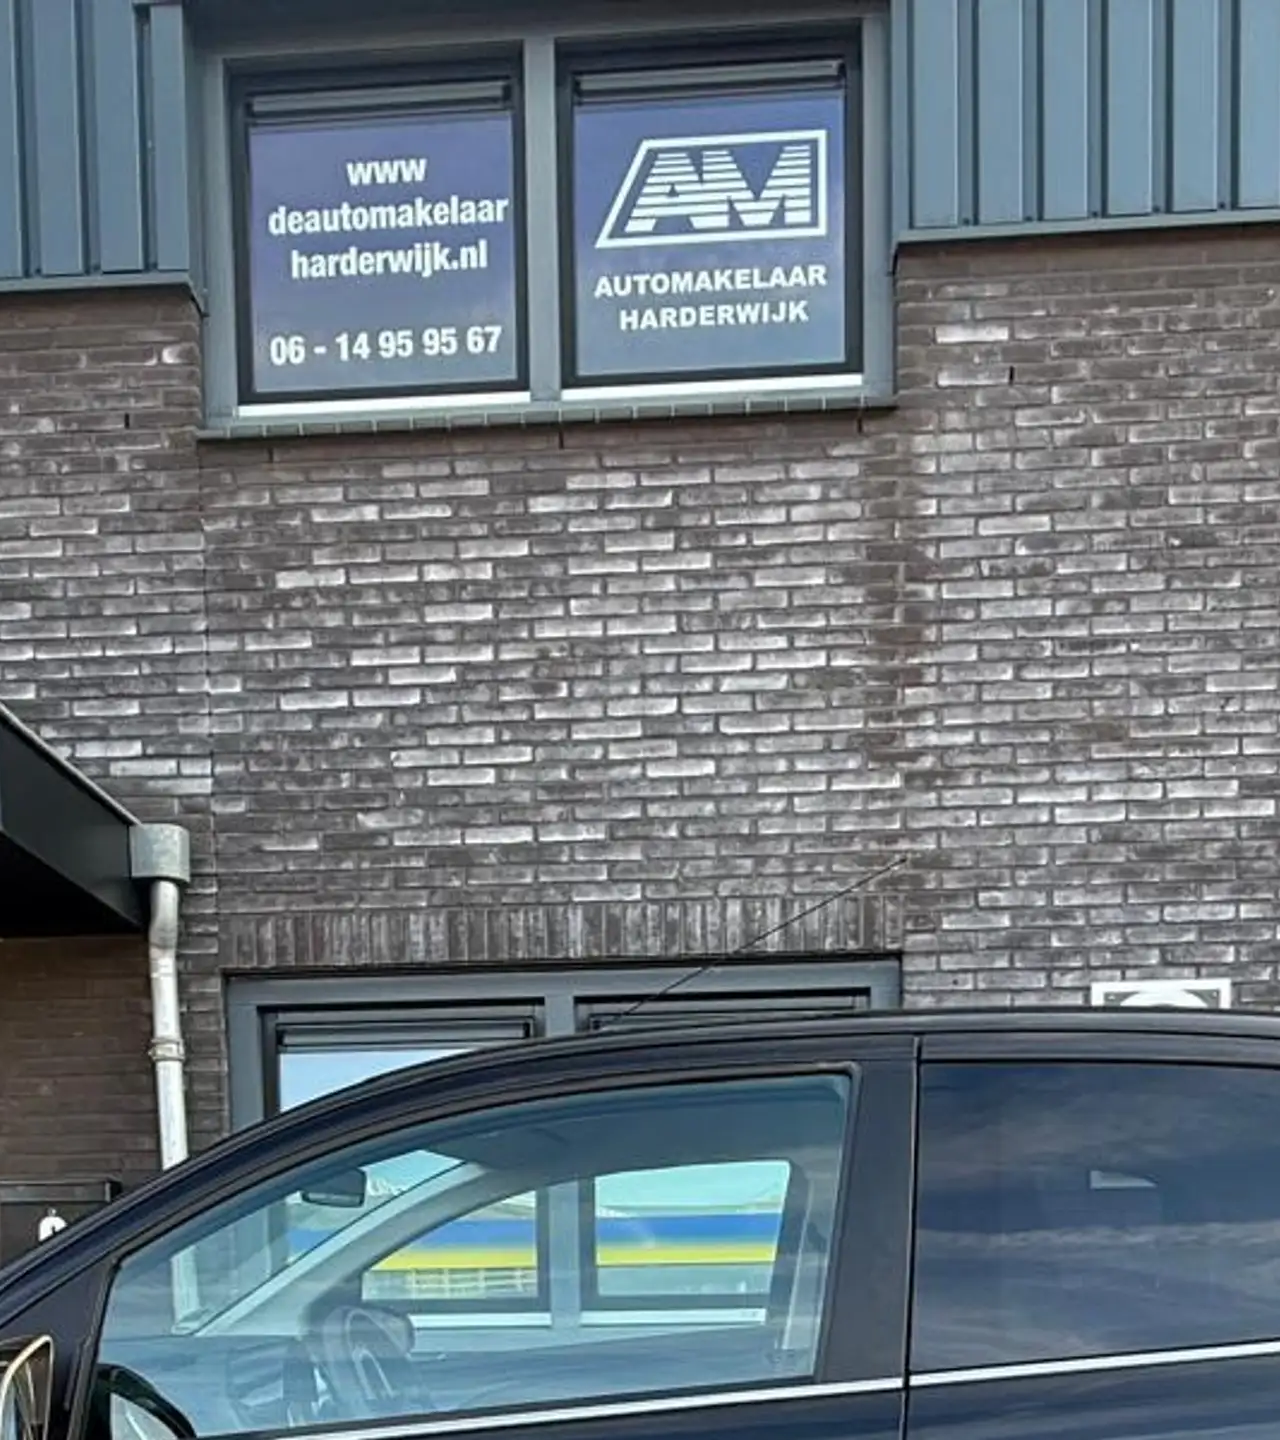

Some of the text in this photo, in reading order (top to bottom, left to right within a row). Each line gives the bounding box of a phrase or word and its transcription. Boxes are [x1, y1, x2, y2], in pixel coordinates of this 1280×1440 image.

[346, 158, 427, 186] www
[268, 196, 509, 235] deautomakelaar
[291, 239, 489, 279] harderwijk.nl
[593, 264, 827, 299] AUTOMAKELAAR
[619, 299, 809, 332] HARDERWIJK
[270, 325, 502, 366] 06 - 14 95 95 67
